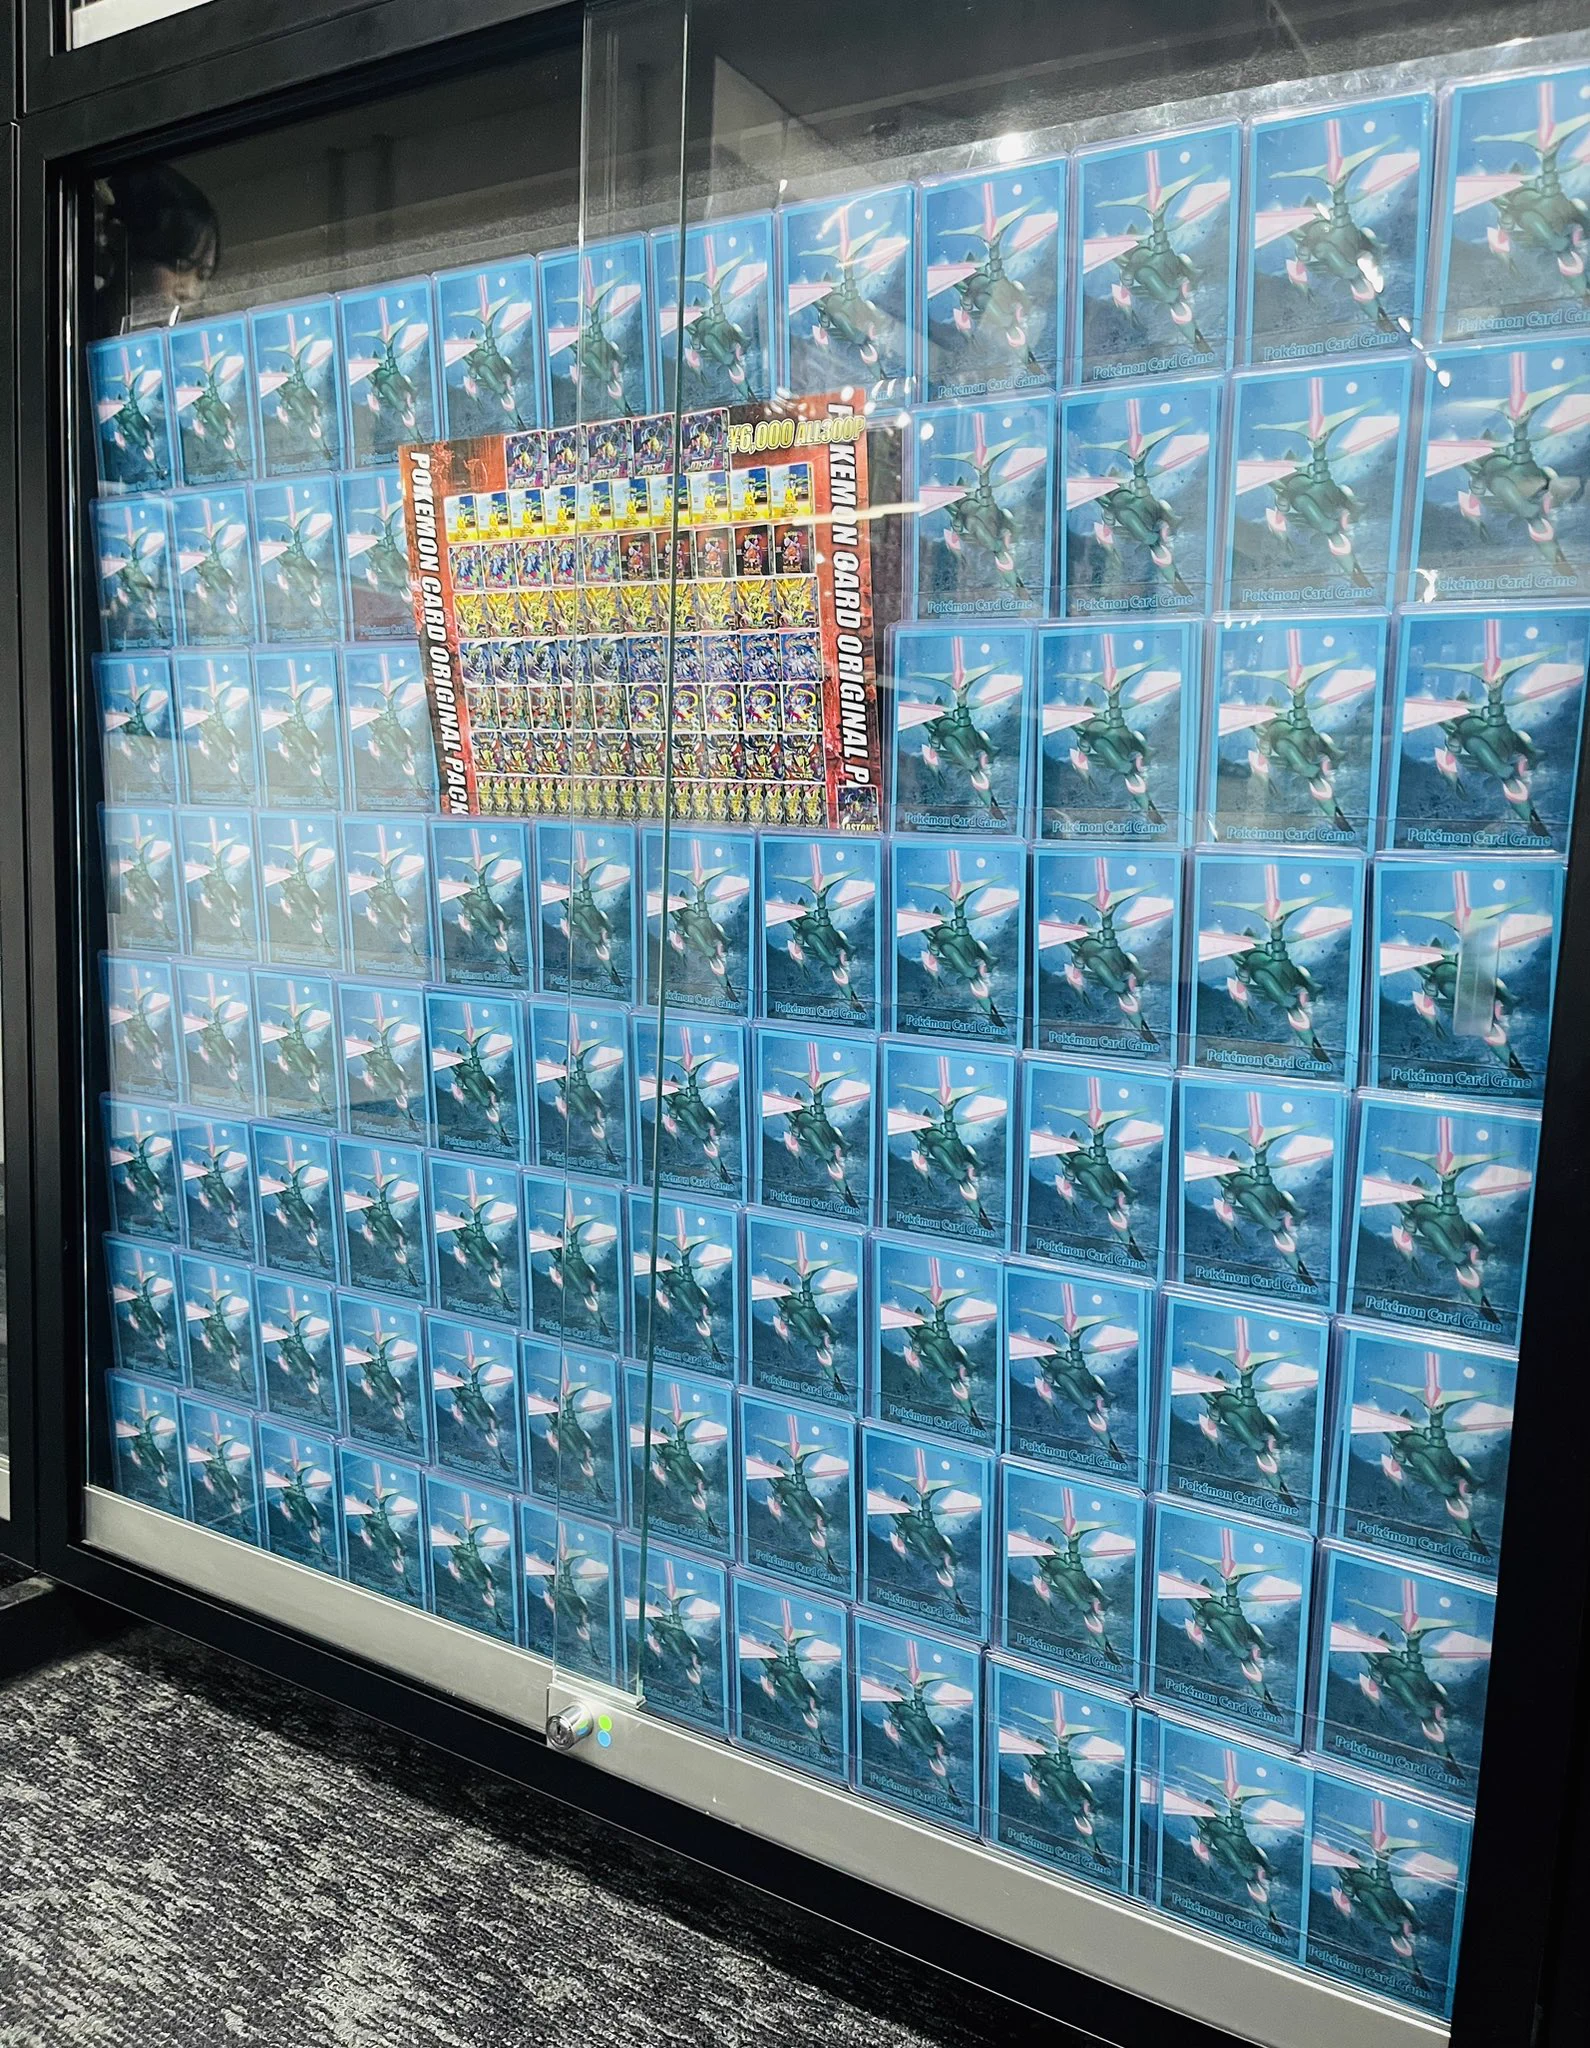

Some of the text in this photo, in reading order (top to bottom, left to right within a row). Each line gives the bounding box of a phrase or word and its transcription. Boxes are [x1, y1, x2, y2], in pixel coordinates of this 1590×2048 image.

[1459, 315, 1524, 332] Pokémon
[1526, 309, 1561, 327] Card
[1264, 332, 1399, 361] Pokémon Card Game
[1093, 352, 1214, 380] Pokémon Card Game
[937, 374, 1046, 399] Pokémon Card Game
[727, 415, 866, 454] ¥6,000 ALL300P
[828, 403, 858, 547] PKEMON
[832, 550, 861, 630] CARD
[1497, 574, 1532, 589] Card
[1534, 573, 1577, 588] Game
[927, 597, 1033, 613] Pokémon Card Game
[1077, 594, 1193, 611] Pokémon Card Game
[1243, 585, 1373, 602] Pokémon Card Game
[409, 451, 470, 816] POKEMON CARD ORIGINAL PACK
[836, 633, 869, 758] ORIGINAL
[951, 814, 976, 827] Card
[1052, 820, 1167, 833] Pokémon Card Game
[1227, 826, 1355, 841] Pokémon Card Game
[1408, 828, 1551, 846] Pokémon Card Game
[816, 1006, 838, 1018] Card
[952, 1019, 976, 1032] Card
[1049, 1031, 1160, 1052] Pokémon Card Game
[1207, 1048, 1332, 1072] Pokémon Card Game
[1391, 1067, 1454, 1084] Pokémon
[1455, 1071, 1489, 1086] Card
[1491, 1074, 1532, 1088] Game
[811, 1197, 833, 1210] Card
[942, 1219, 966, 1233] Card
[1037, 1237, 1147, 1270] Pokémon Card Game
[1196, 1265, 1250, 1285] Pokémon
[1251, 1274, 1281, 1289] Card
[1282, 1279, 1318, 1295] Game
[1366, 1295, 1426, 1319] Pokémon
[1428, 1308, 1460, 1325] Card
[1462, 1315, 1502, 1333] Game
[801, 1382, 822, 1396] Card
[934, 1416, 957, 1431] Card
[1021, 1437, 1128, 1472] Pokémon Card Game
[1179, 1477, 1299, 1517] Pokémon Card Game
[1357, 1519, 1492, 1566] Pokémon Card Game
[796, 1563, 817, 1577] Card
[919, 1602, 942, 1618] Card
[1017, 1631, 1123, 1674] Pokémon Card Game
[1165, 1677, 1283, 1725] Pokémon Card Game
[1335, 1734, 1466, 1787] Pokémon Card Game
[1225, 1913, 1252, 1932] Card
[1253, 1924, 1287, 1945] Game
[1365, 1967, 1394, 1987] Card
[1396, 1979, 1432, 2002] Game
